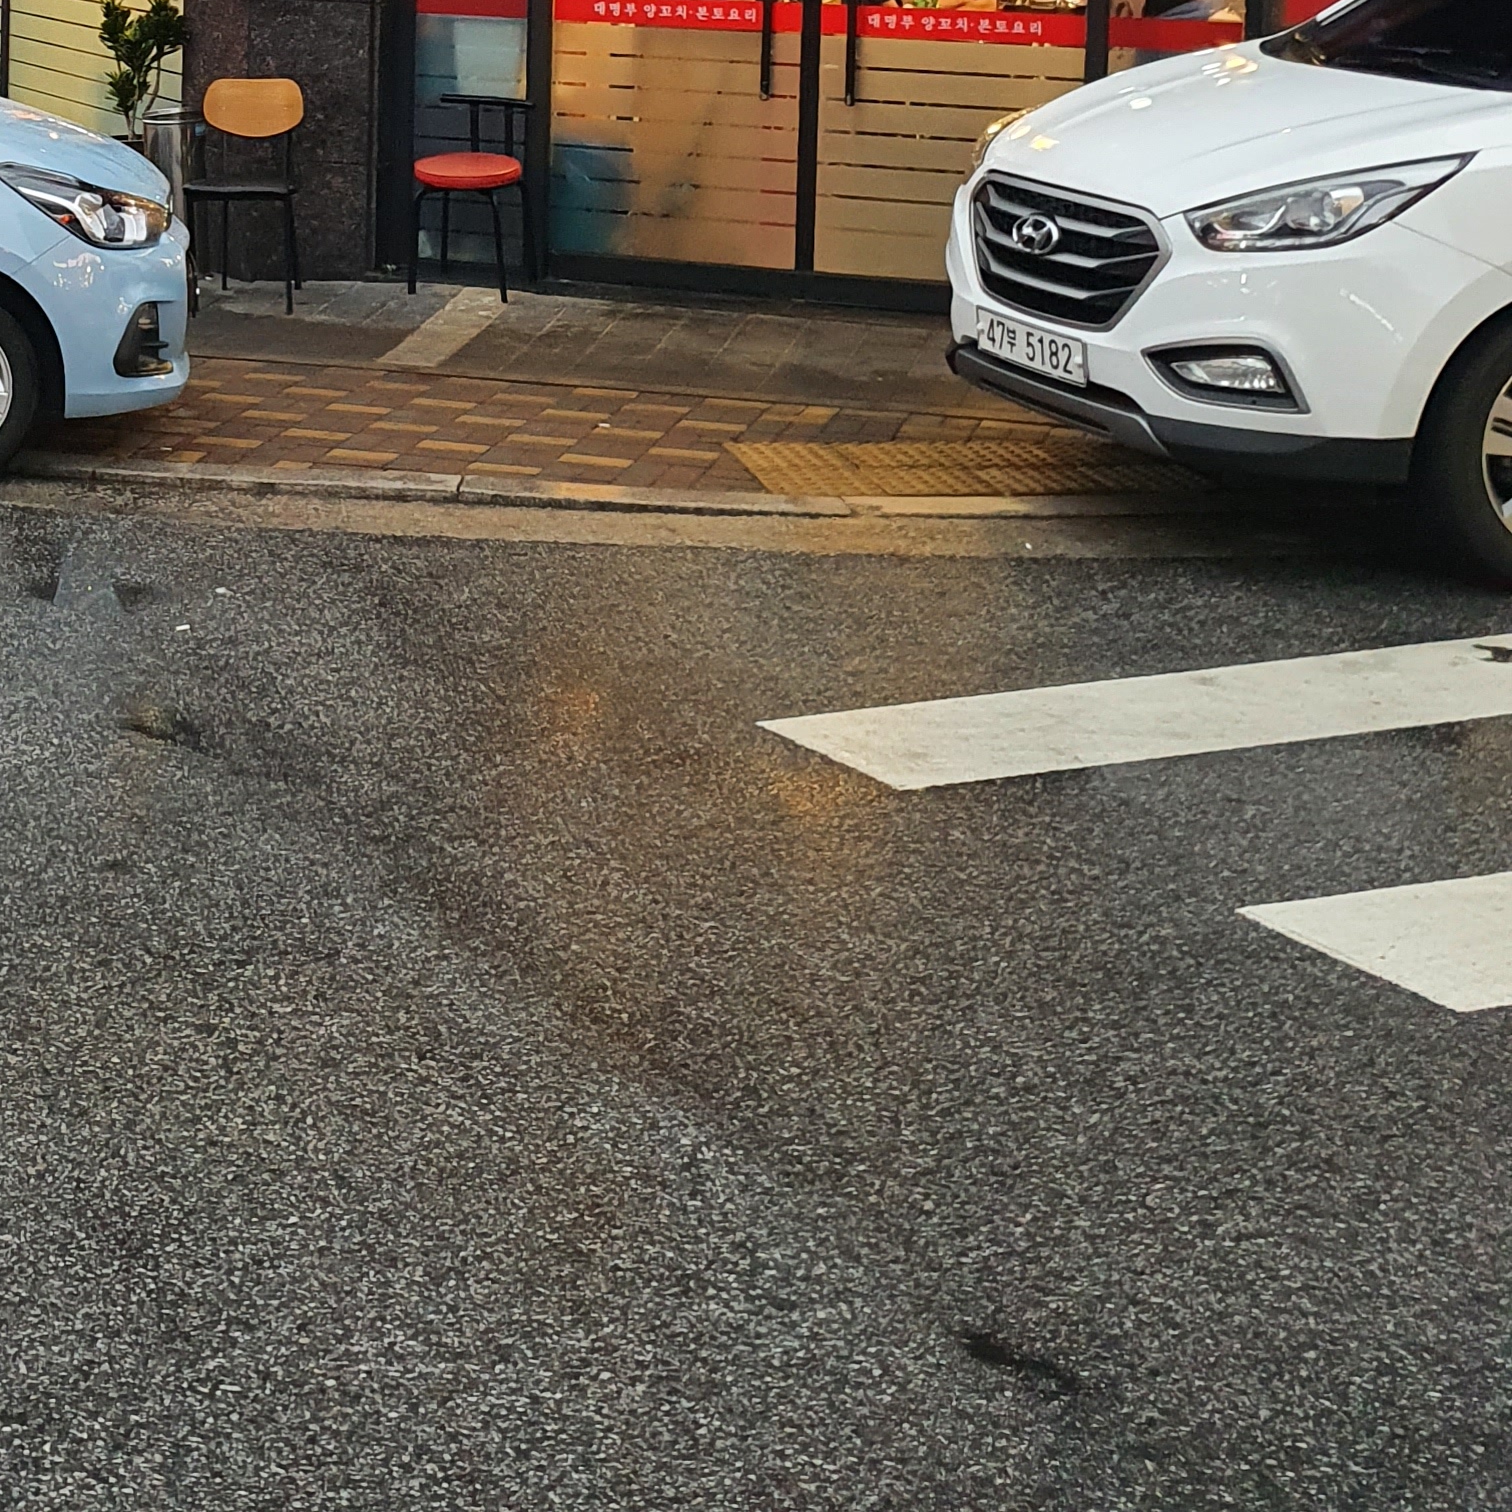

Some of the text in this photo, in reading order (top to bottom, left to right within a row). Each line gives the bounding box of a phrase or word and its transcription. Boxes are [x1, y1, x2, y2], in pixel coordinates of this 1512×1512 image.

[594, 1, 638, 15] 대명부
[867, 13, 915, 30] 대명부
[987, 318, 1073, 375] 47부 5182
